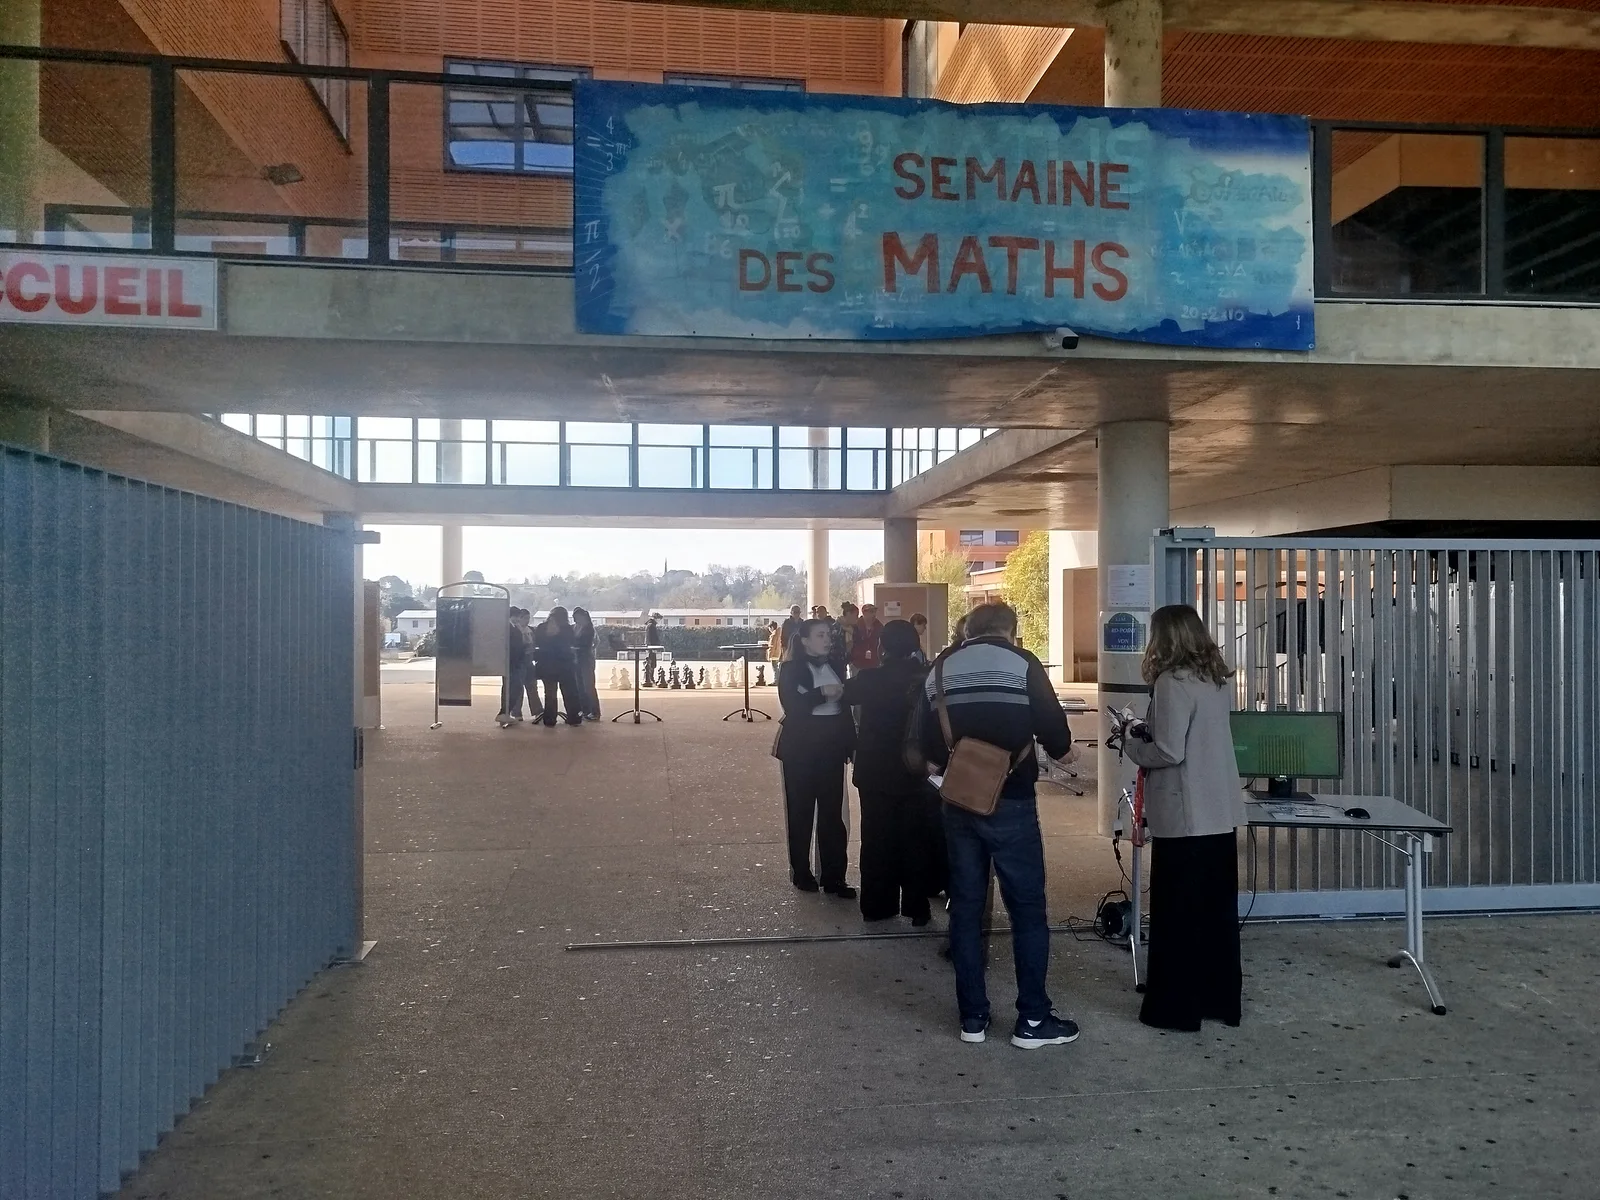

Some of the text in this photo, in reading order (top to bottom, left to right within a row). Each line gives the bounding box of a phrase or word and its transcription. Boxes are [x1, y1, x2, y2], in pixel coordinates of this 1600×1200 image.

[893, 152, 1130, 210] SEMAINE
[0, 261, 203, 318] CUEIL
[738, 231, 1130, 302] DES MATHS
